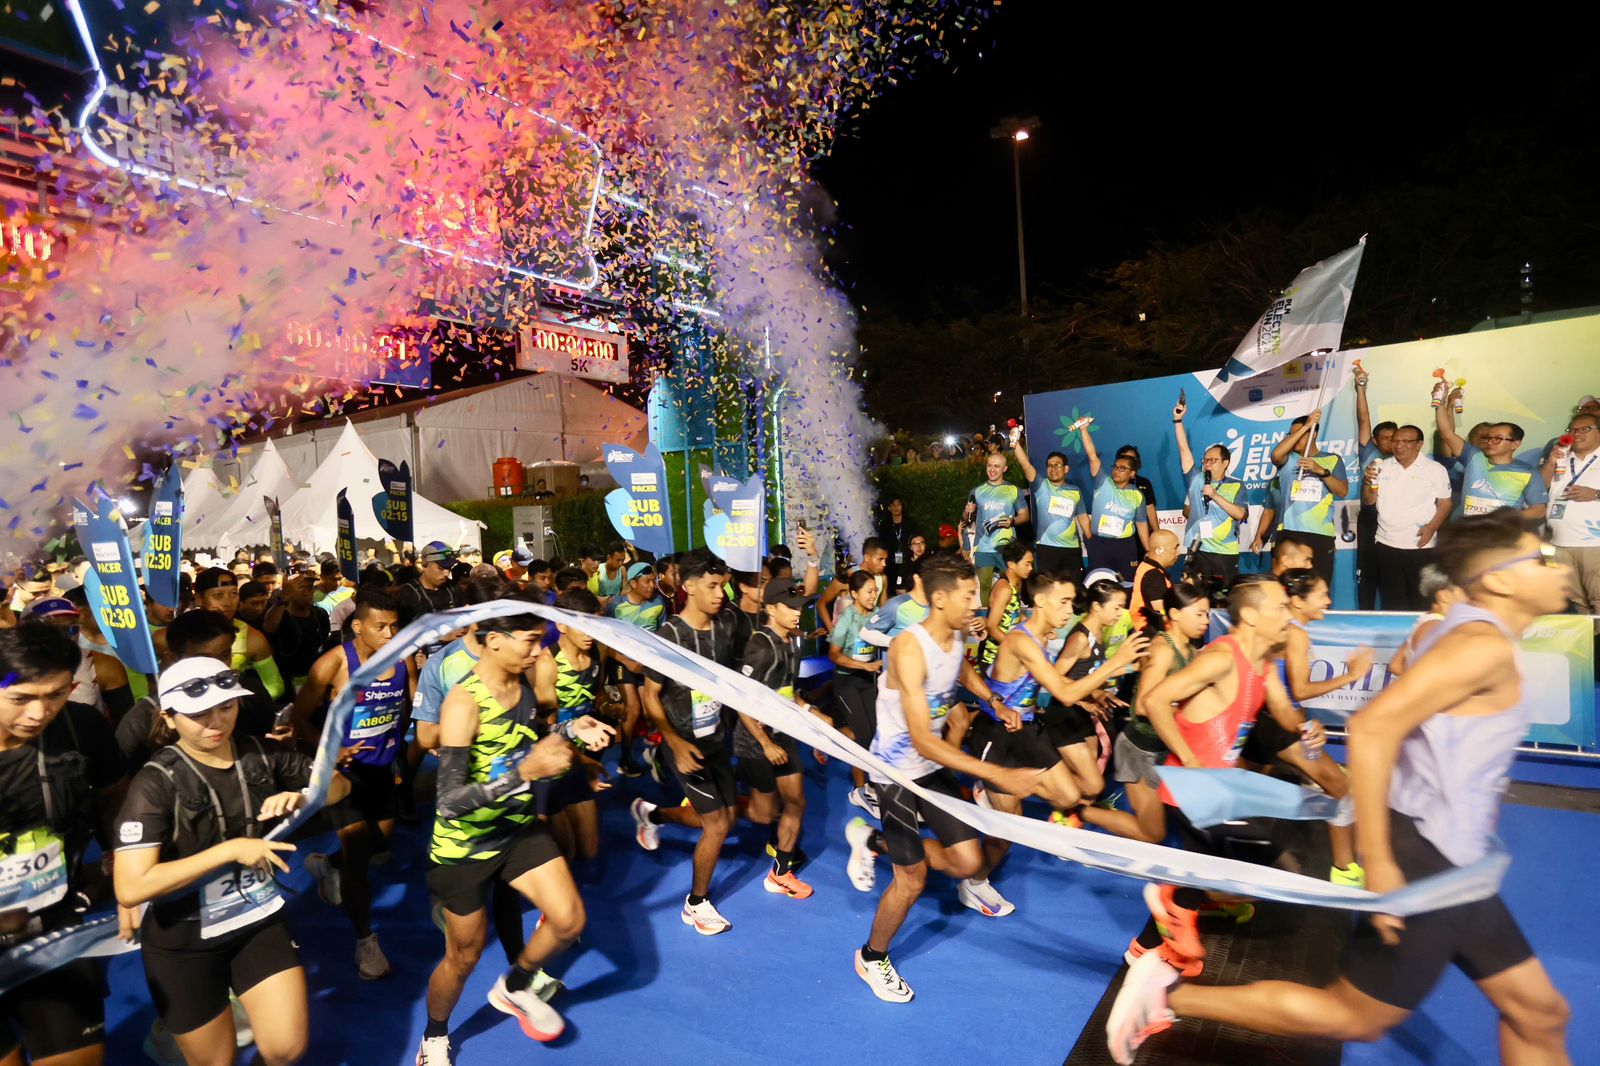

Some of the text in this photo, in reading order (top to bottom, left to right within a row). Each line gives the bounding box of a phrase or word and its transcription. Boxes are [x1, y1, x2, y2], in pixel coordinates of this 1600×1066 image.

[1284, 298, 1292, 315] PLN
[571, 359, 589, 373] 5K
[1250, 431, 1285, 446] PLN
[1243, 463, 1279, 482] RU
[386, 500, 407, 511] SUB
[628, 499, 660, 513] SUB
[381, 510, 408, 521] 02:15
[622, 513, 664, 527] 02:00
[149, 534, 172, 552] SUB
[97, 562, 122, 573] PACER
[144, 552, 172, 571] 02:30
[99, 584, 130, 606] SUB
[100, 607, 137, 629] 02:30
[365, 688, 404, 701] Shipper
[356, 713, 393, 728] A1808
